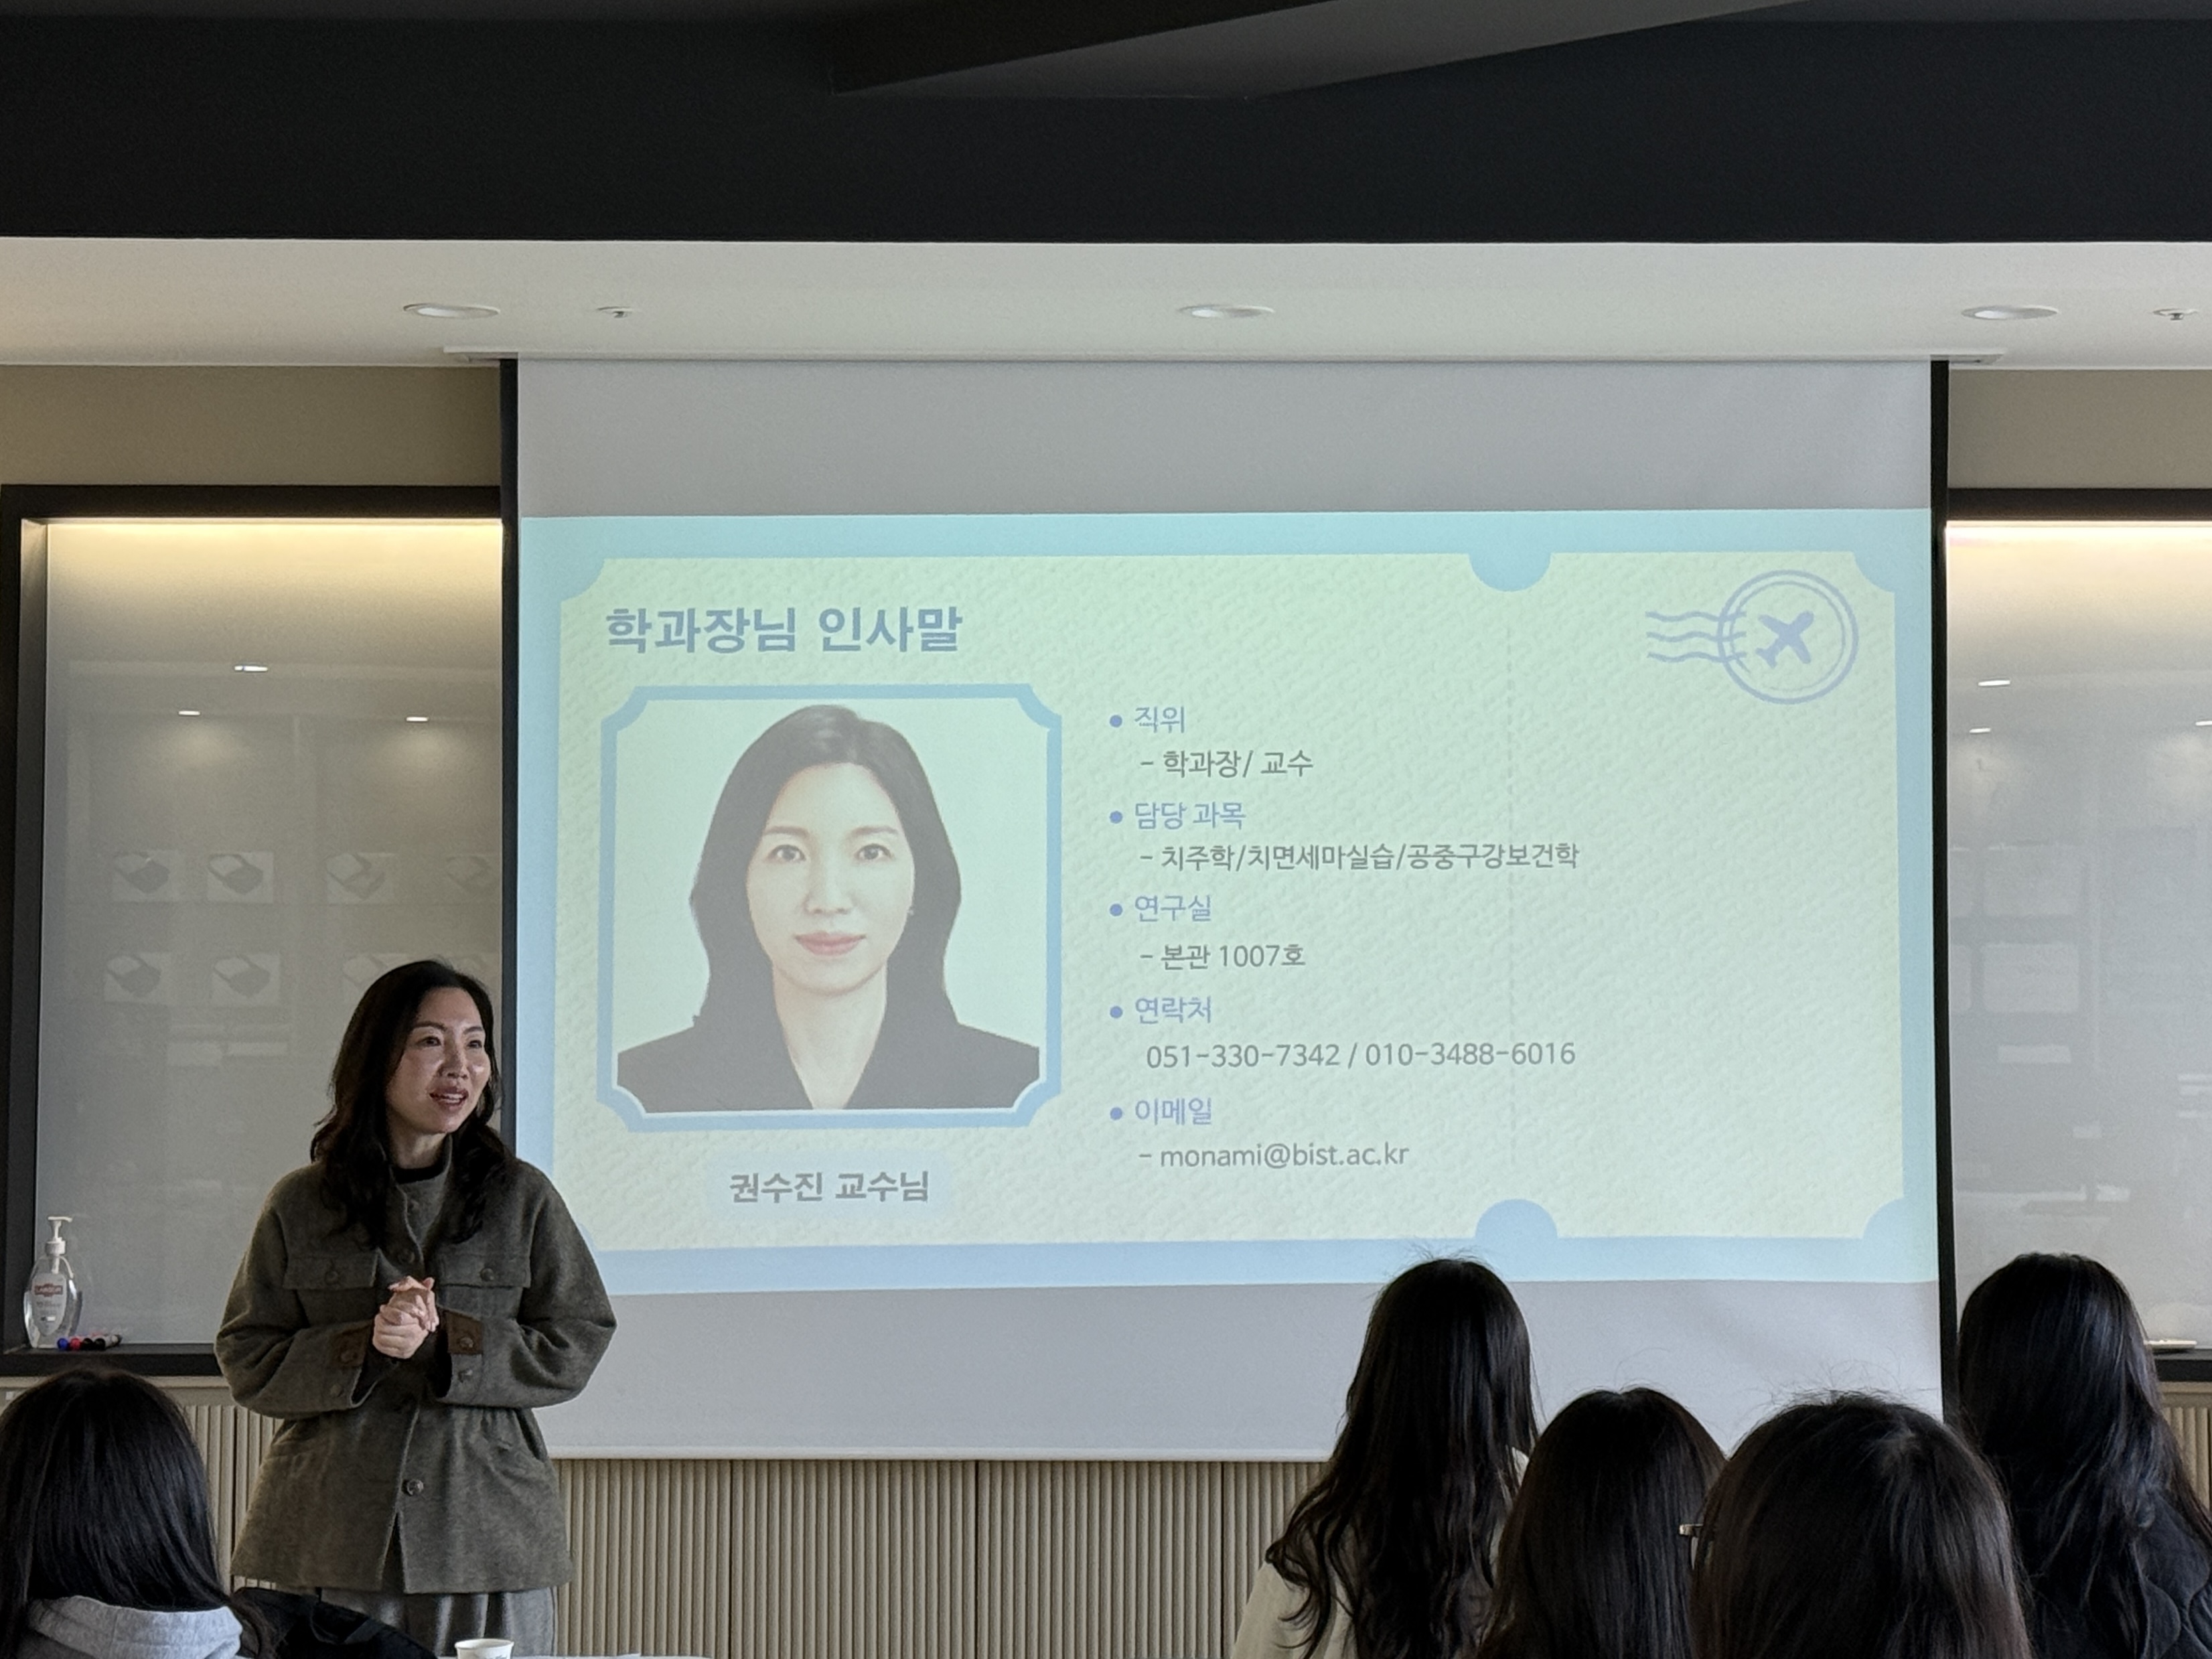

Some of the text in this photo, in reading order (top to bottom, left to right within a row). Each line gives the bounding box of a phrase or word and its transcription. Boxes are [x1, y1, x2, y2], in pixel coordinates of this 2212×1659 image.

[605, 605, 963, 654] 학과장님 인사말
[1134, 705, 1185, 734] 직위
[1163, 749, 1254, 779] 학과장/
[1260, 749, 1314, 778] 교수
[1134, 801, 1247, 831] 담당 과목
[1161, 843, 1580, 872] 치주학/치면세마실습/공중구강보건학
[1134, 894, 1212, 923] 연구실
[1161, 944, 1211, 970] 본관
[1220, 944, 1307, 968] 1007호
[1134, 995, 1212, 1025] 연락처
[1146, 1043, 1341, 1069] 051-330-7342
[1365, 1041, 1576, 1066] 010-3488-6016
[1134, 1097, 1212, 1126] 이메일
[1161, 1141, 1410, 1169] monami@bist.ac.kr
[729, 1170, 929, 1204] 권수진 교수님
